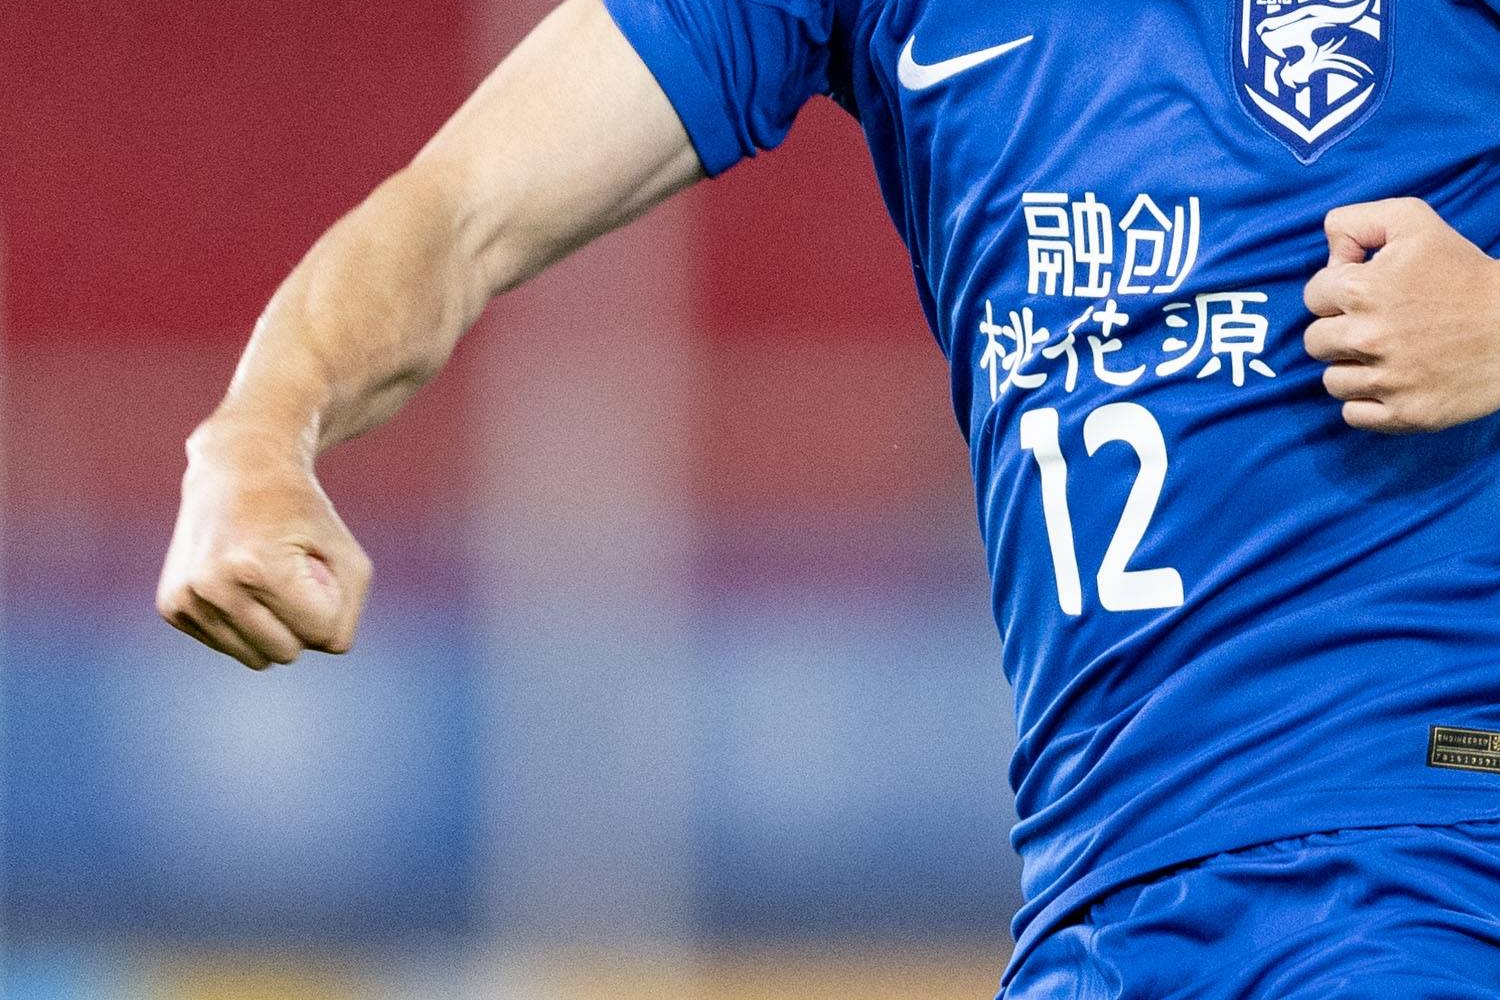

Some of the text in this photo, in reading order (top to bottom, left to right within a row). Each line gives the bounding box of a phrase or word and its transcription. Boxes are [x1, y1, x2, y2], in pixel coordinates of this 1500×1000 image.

[1021, 192, 1201, 297] 融创
[979, 291, 1276, 402] 桃花源
[1020, 402, 1184, 616] 12
